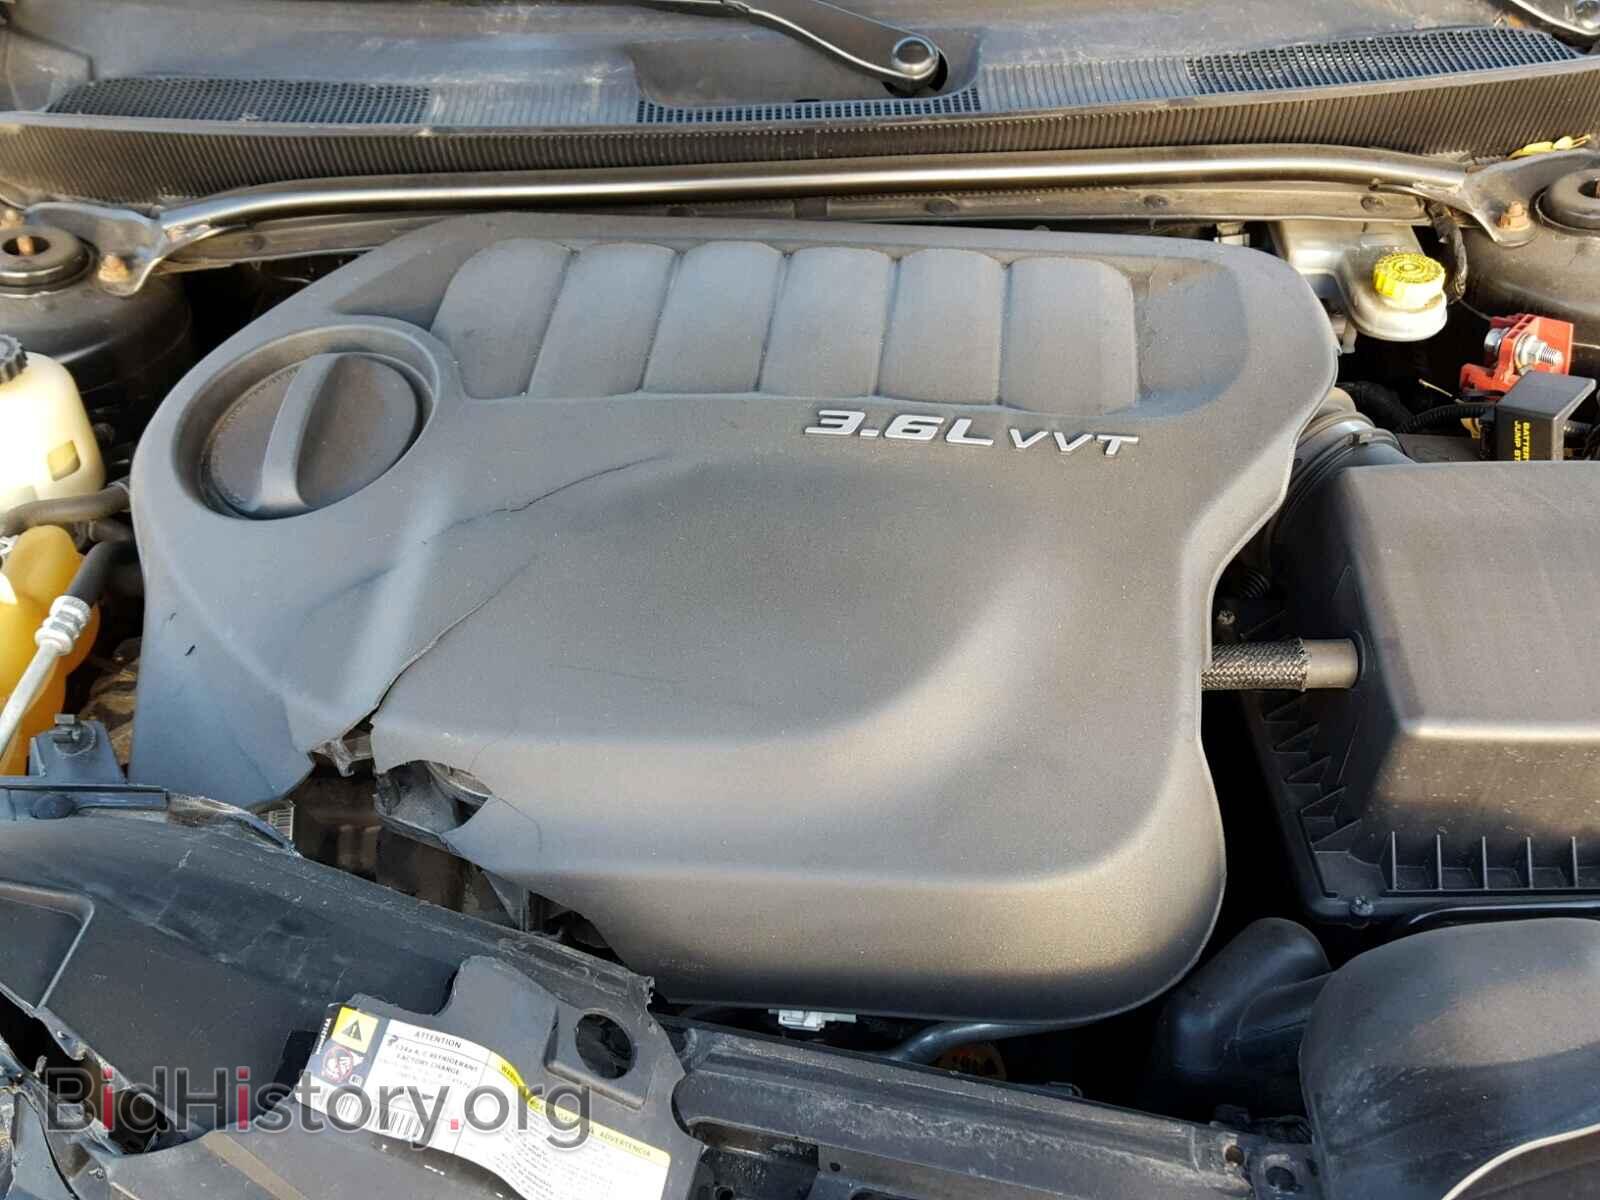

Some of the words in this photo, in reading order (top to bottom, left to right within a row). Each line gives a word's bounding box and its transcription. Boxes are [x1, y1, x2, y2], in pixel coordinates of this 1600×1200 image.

[804, 409, 994, 447] 3.6L
[1008, 428, 1140, 458] VVT
[414, 1031, 462, 1049] ATTENTION
